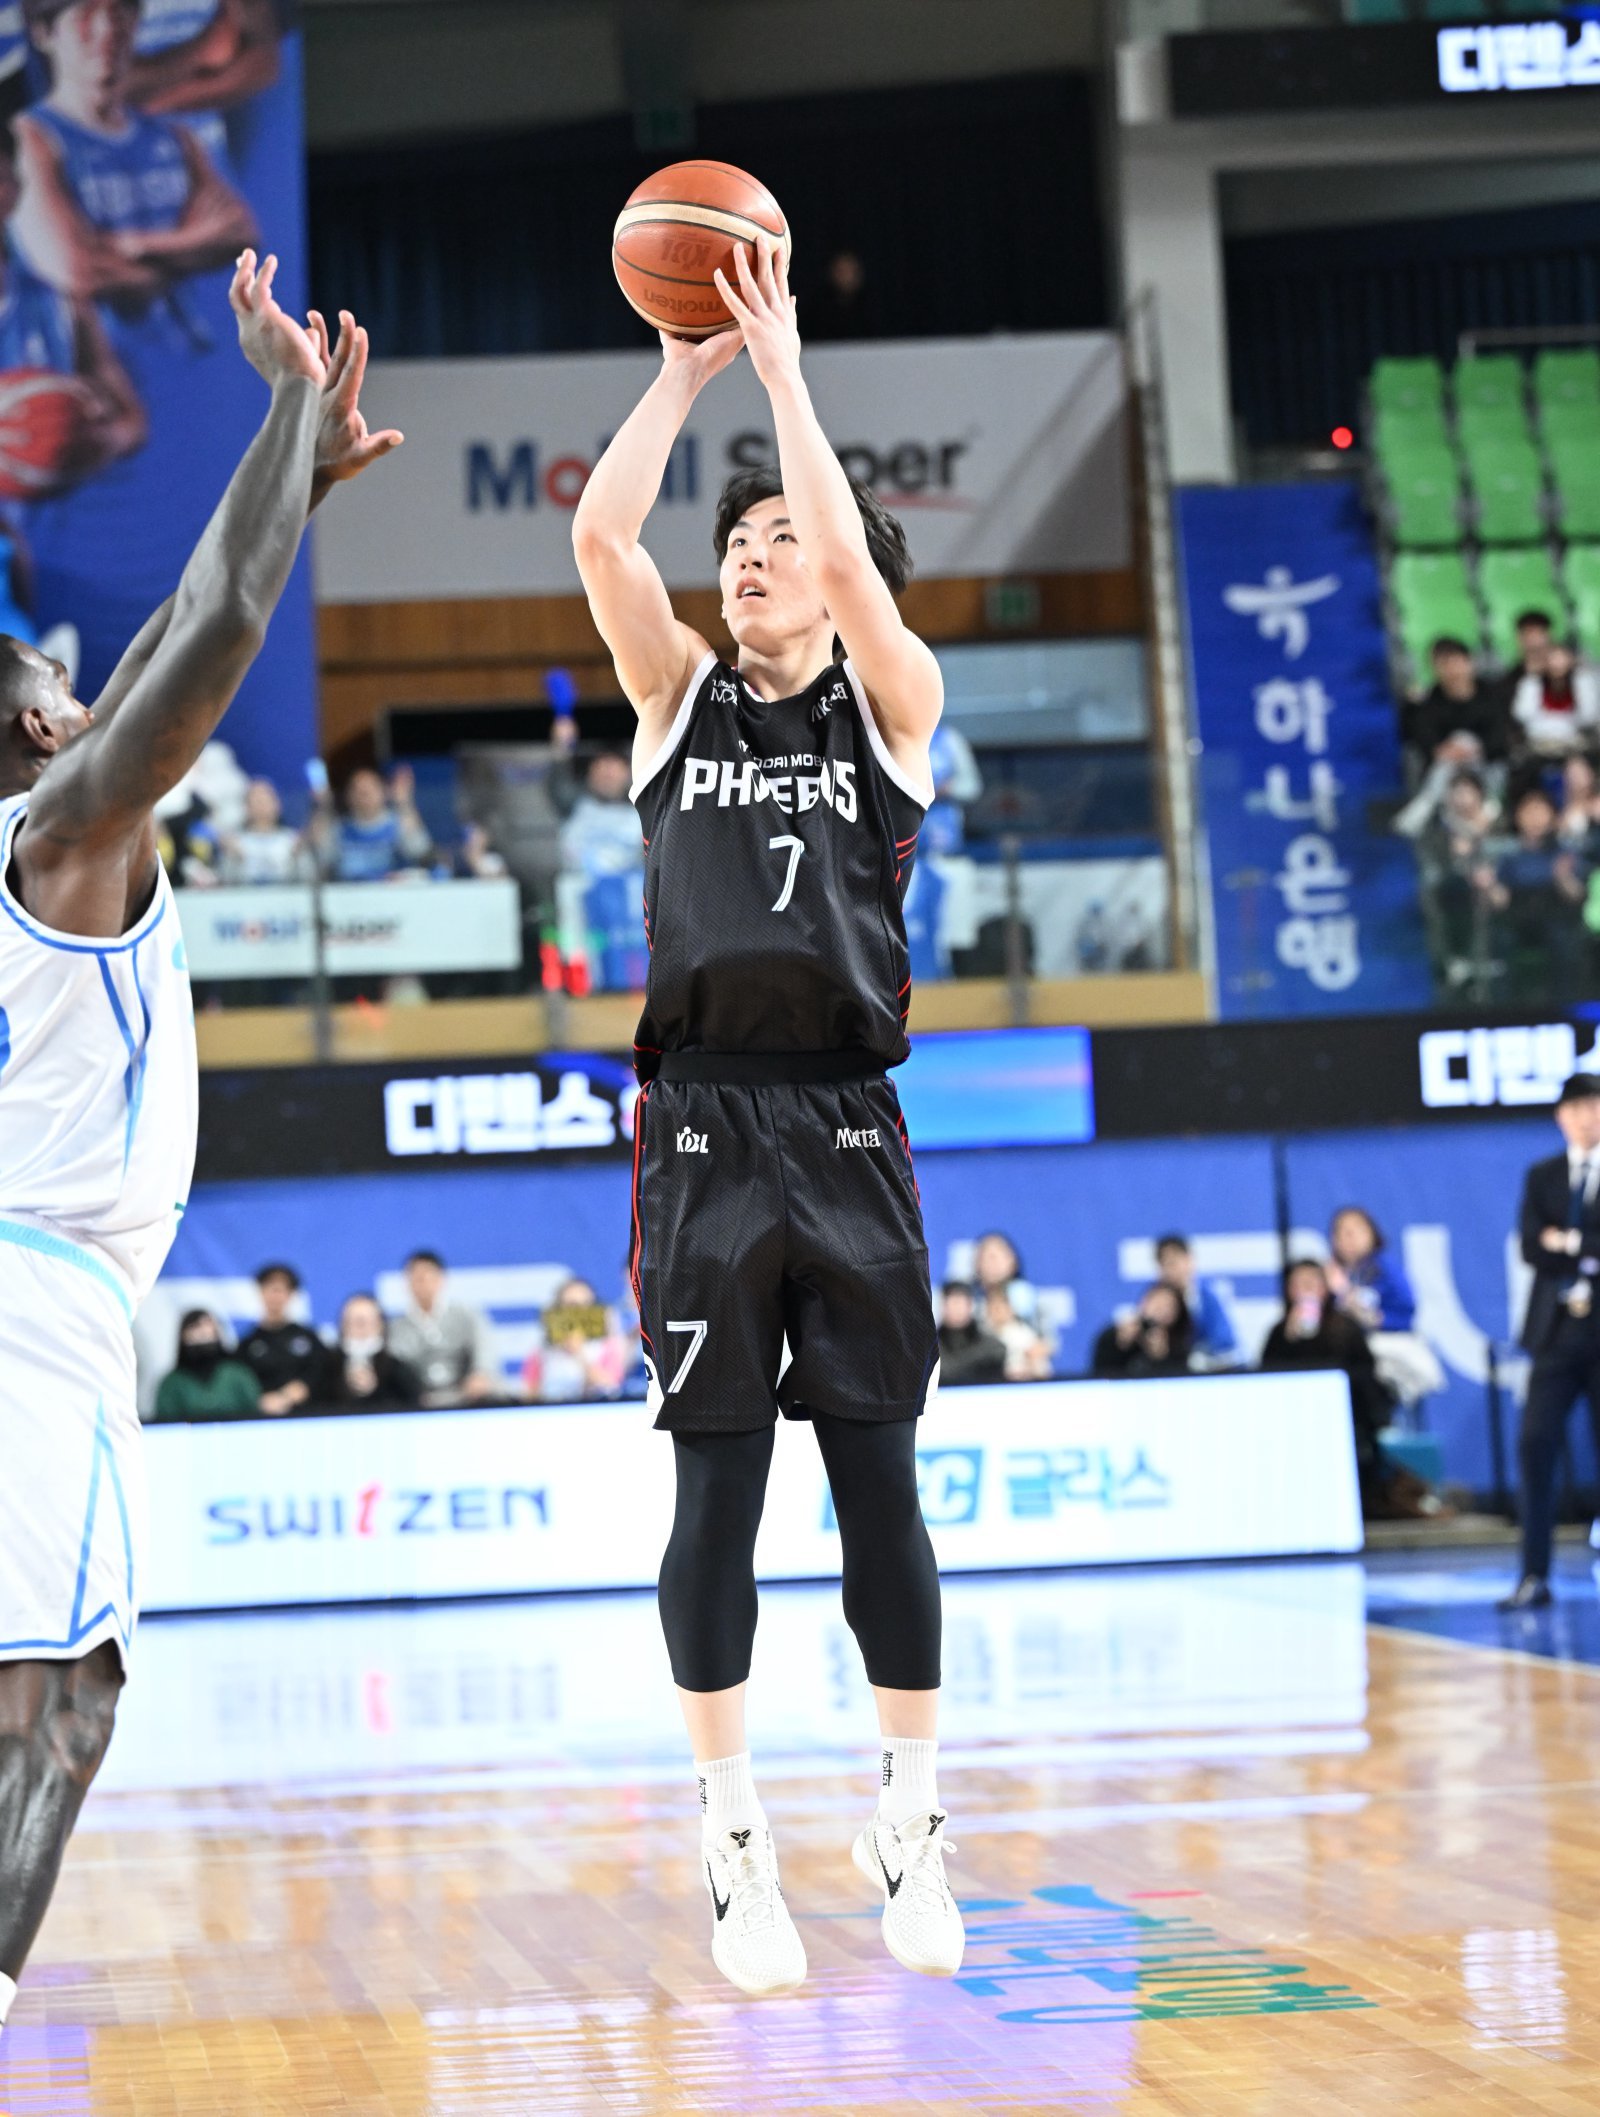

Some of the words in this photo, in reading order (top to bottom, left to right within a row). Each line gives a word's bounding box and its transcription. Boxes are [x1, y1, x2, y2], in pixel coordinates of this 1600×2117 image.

[644, 288, 722, 313] molten
[466, 434, 699, 508] Moil
[727, 431, 964, 493] Sper
[680, 757, 858, 823] PHOEBUS
[1252, 676, 1361, 992] 하나은행
[769, 834, 805, 911] 7
[676, 1126, 709, 1153] KBL
[666, 1320, 707, 1393] 7
[1006, 1447, 1172, 1518] 글라스
